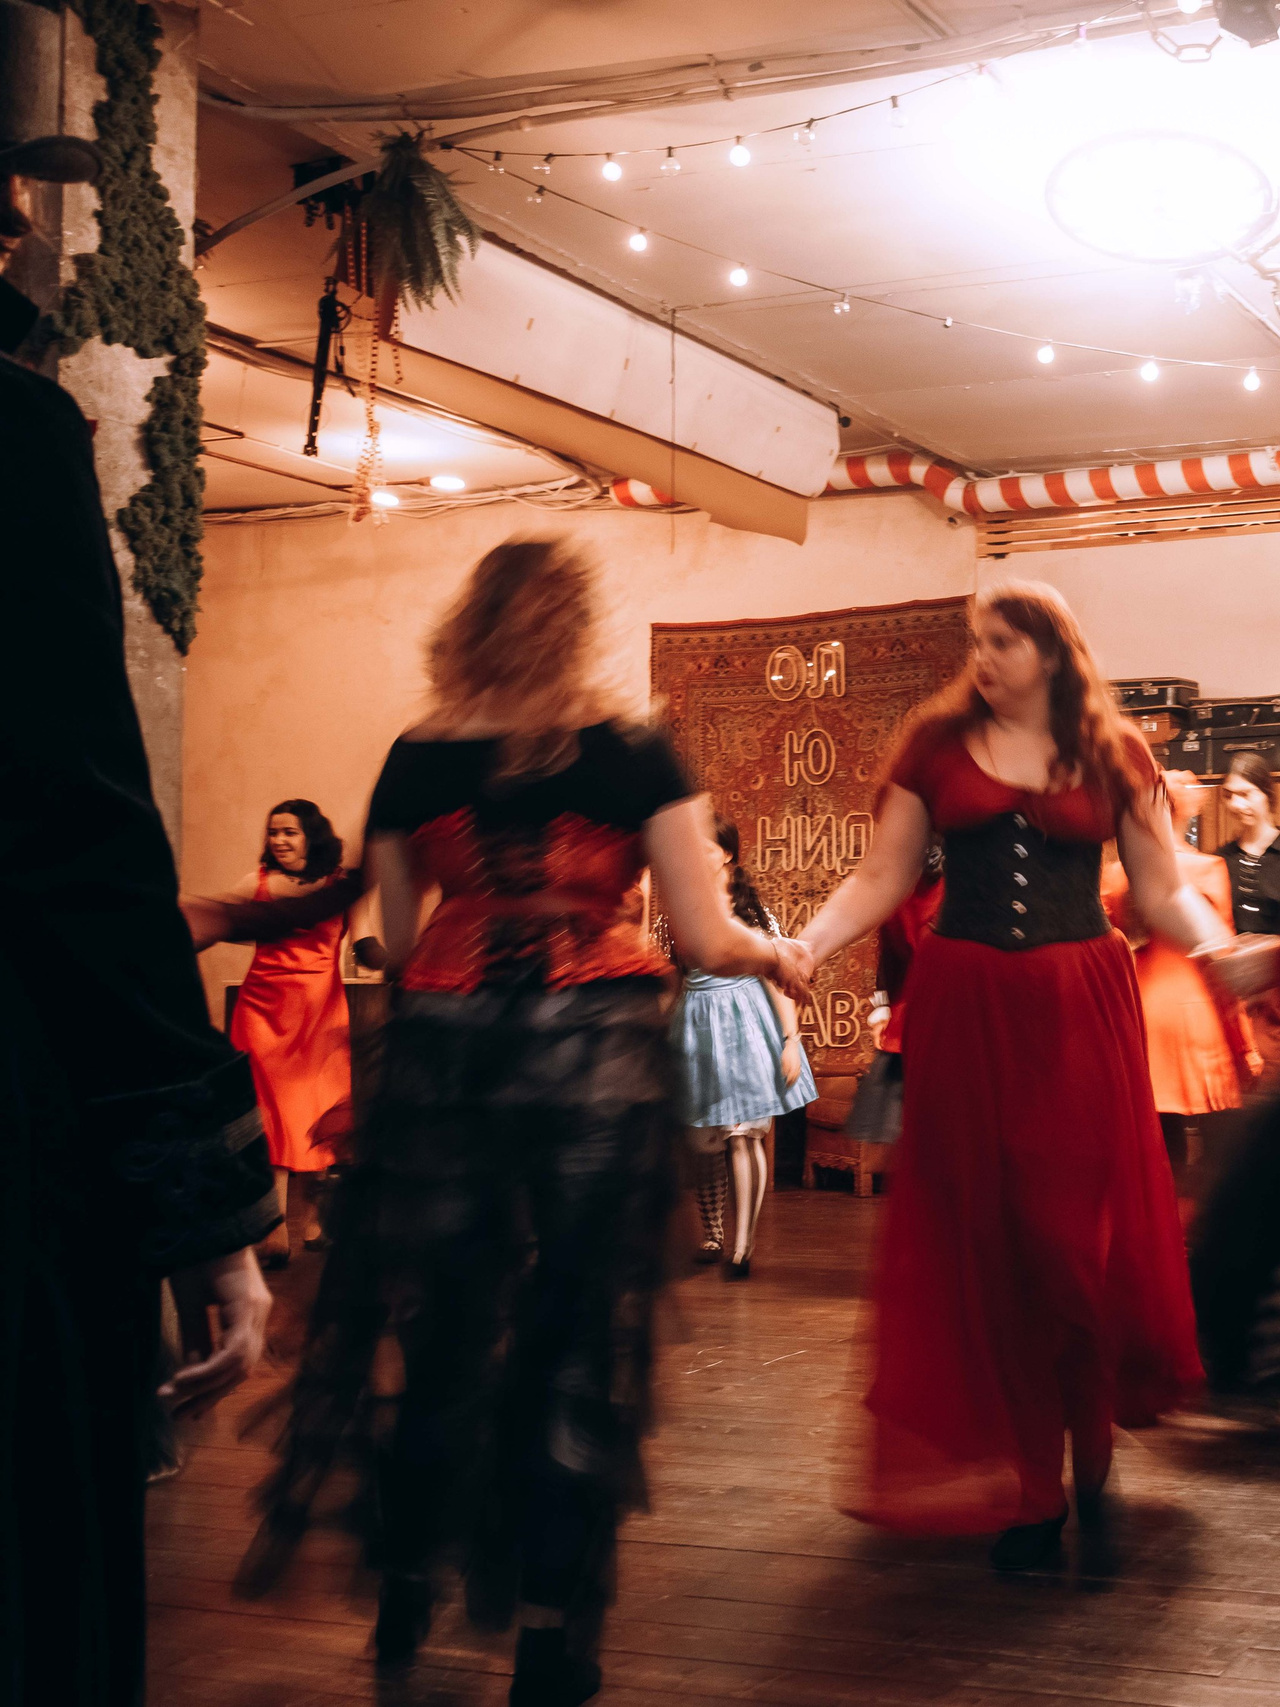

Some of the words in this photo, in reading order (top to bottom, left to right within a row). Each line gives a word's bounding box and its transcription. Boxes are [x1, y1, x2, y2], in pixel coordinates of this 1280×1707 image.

[765, 641, 846, 701] ОЛ
[784, 728, 836, 787] Ю
[757, 812, 874, 876] НИД
[797, 990, 860, 1048] АВ
